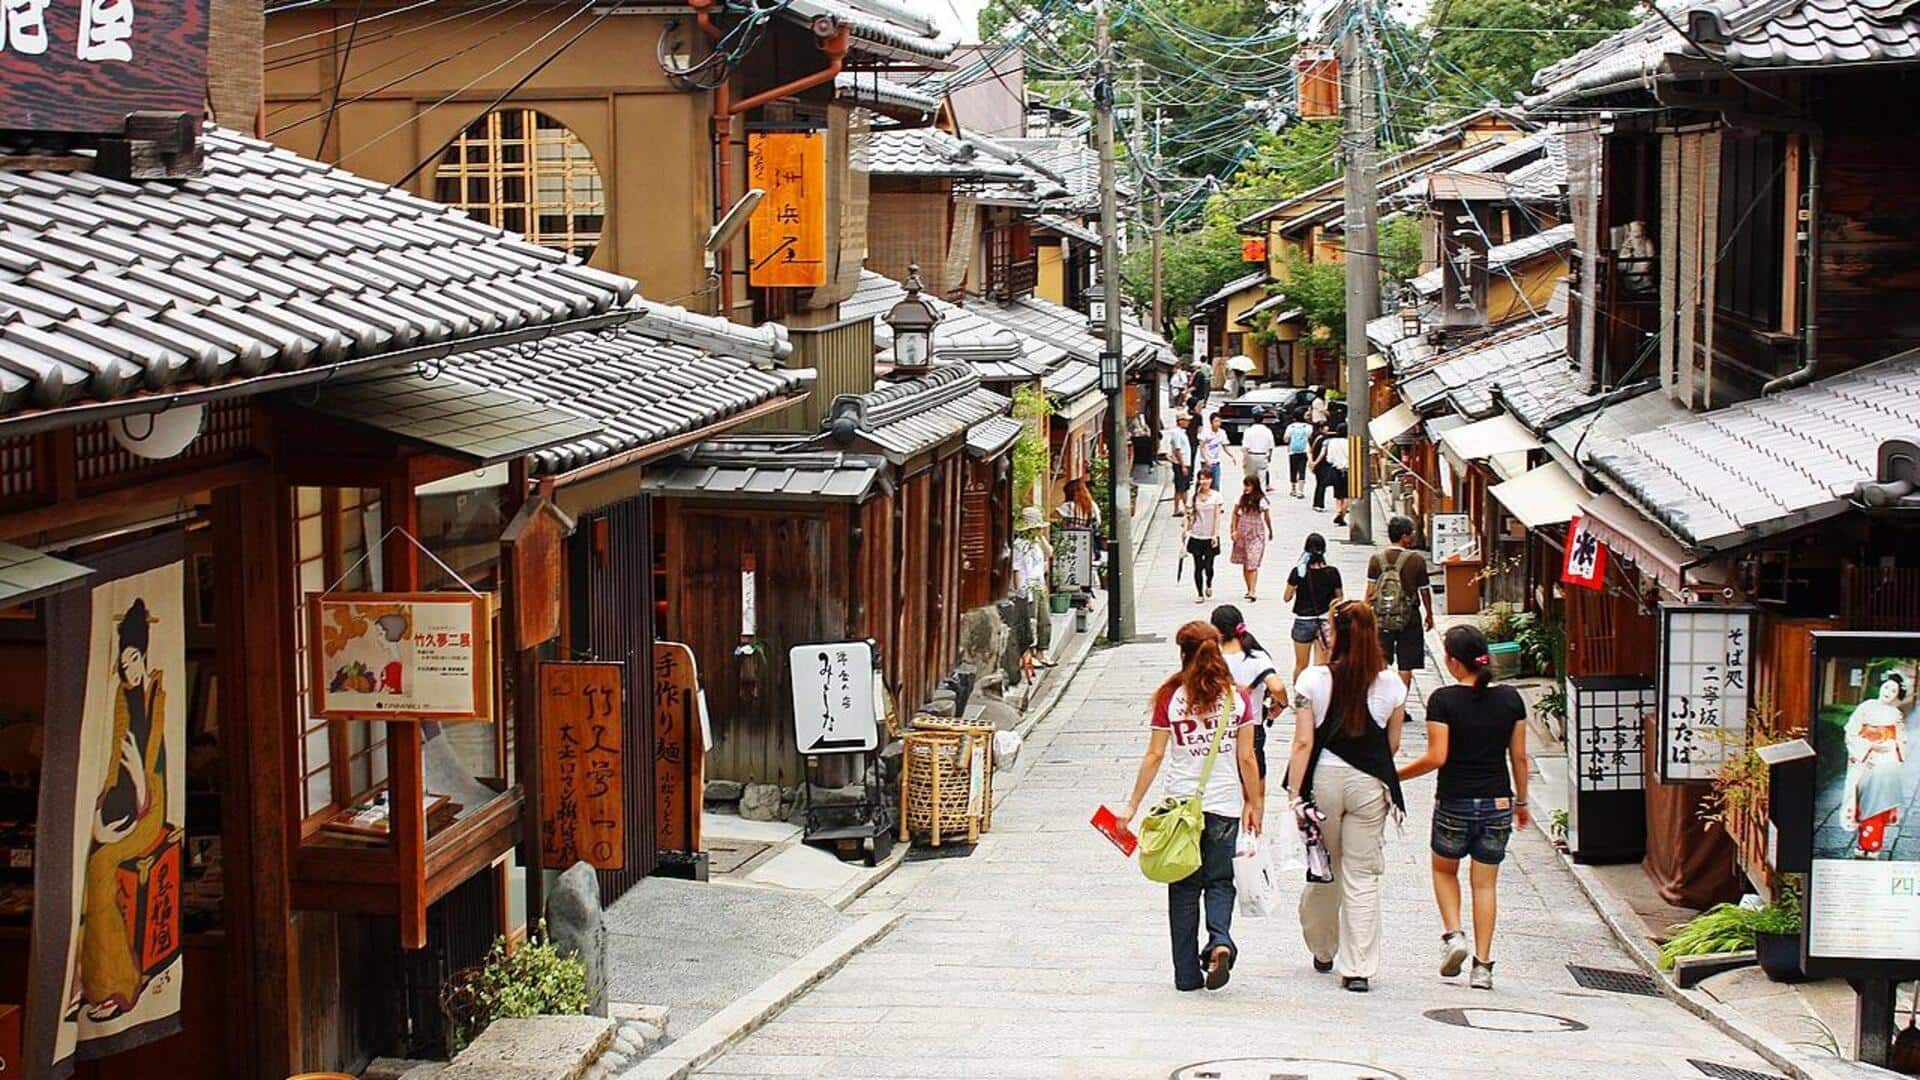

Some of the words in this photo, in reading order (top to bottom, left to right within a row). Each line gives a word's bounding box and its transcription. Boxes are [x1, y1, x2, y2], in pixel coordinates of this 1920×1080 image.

[413, 632, 472, 649] 竹久夢二展
[1724, 628, 1745, 690] そば処
[655, 652, 681, 764] 手作り麺
[1699, 666, 1721, 728] 二寧坂
[1189, 743, 1232, 757] WOLD
[1671, 696, 1698, 765] ふたば
